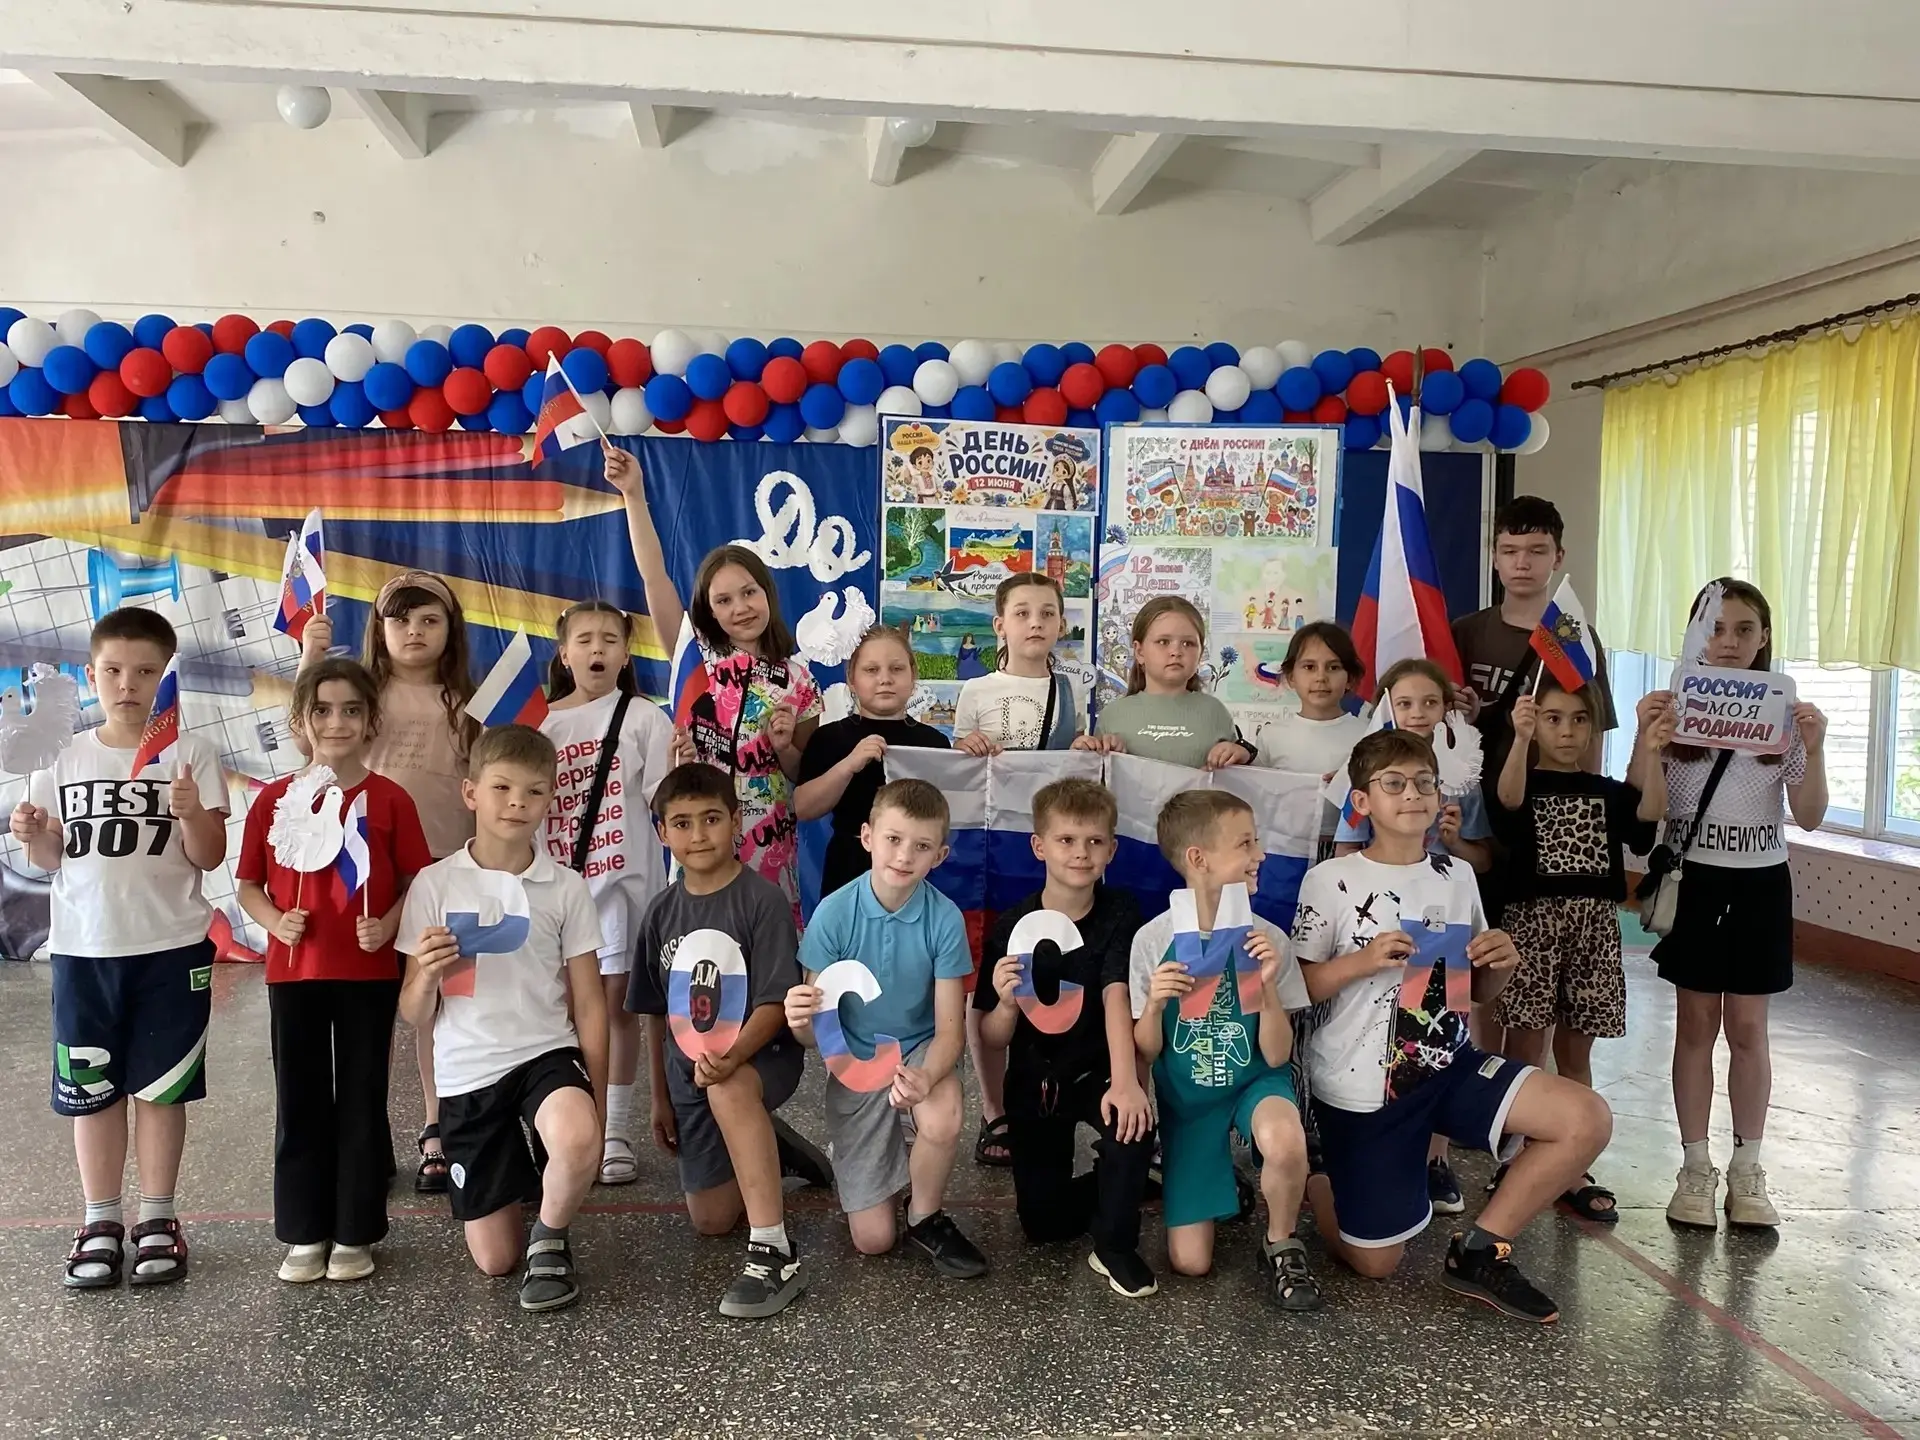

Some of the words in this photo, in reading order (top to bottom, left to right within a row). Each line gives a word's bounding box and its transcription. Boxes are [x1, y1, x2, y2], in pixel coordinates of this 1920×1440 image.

[962, 431, 1029, 454] ДЕНЬ
[1180, 439, 1187, 449] С
[1189, 437, 1220, 450] ДНЁМ
[1222, 439, 1266, 450] РОССИИ!
[949, 453, 1047, 484] РОССИИ!
[974, 479, 985, 487] 12
[987, 478, 1015, 489] ИЮНЯ
[1131, 555, 1152, 573] 12
[973, 570, 1003, 583] Родные
[1132, 574, 1180, 591] День
[971, 583, 998, 593] прост
[1123, 588, 1187, 604] Рос
[1682, 676, 1768, 700] РОССИЯ
[1707, 700, 1763, 719] МОЯ
[1683, 716, 1775, 741] РОДИНА!
[65, 782, 170, 820] BEST
[66, 818, 172, 858] 007
[1214, 1053, 1226, 1087] LEVEL
